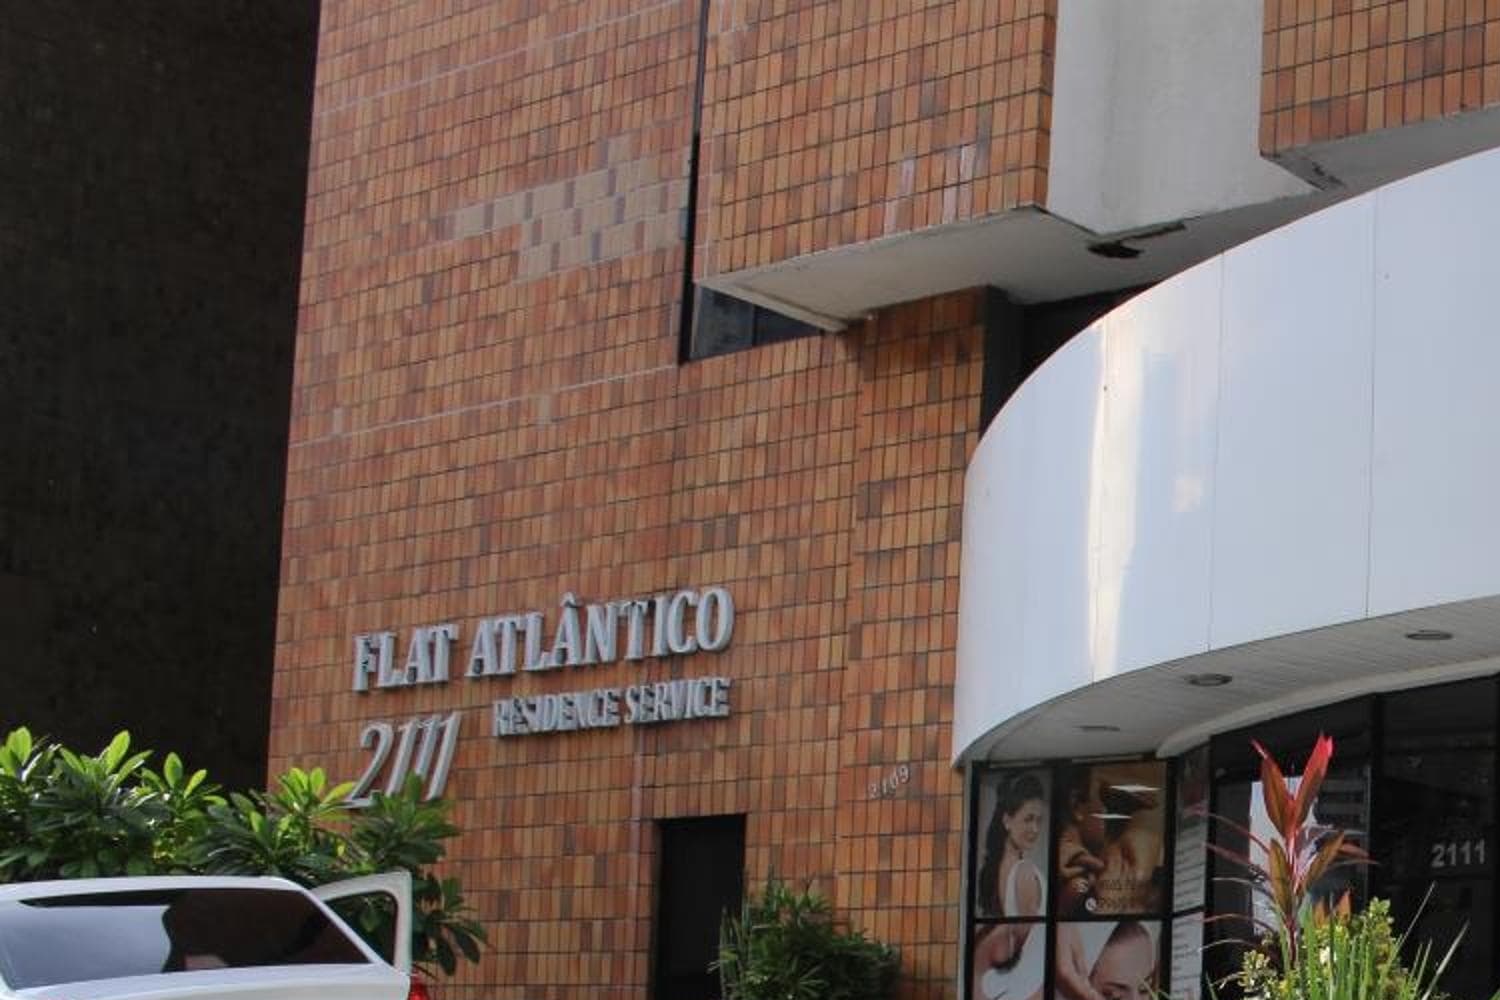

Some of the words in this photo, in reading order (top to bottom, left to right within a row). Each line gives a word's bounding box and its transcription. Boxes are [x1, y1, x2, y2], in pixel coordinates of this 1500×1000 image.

[352, 623, 459, 692] FLAT
[464, 587, 735, 678] ATLÂNTICO
[493, 689, 622, 737] RESIDENCE
[624, 677, 731, 724] SERVICE
[343, 712, 462, 809] 2111
[1431, 839, 1486, 868] 2111
